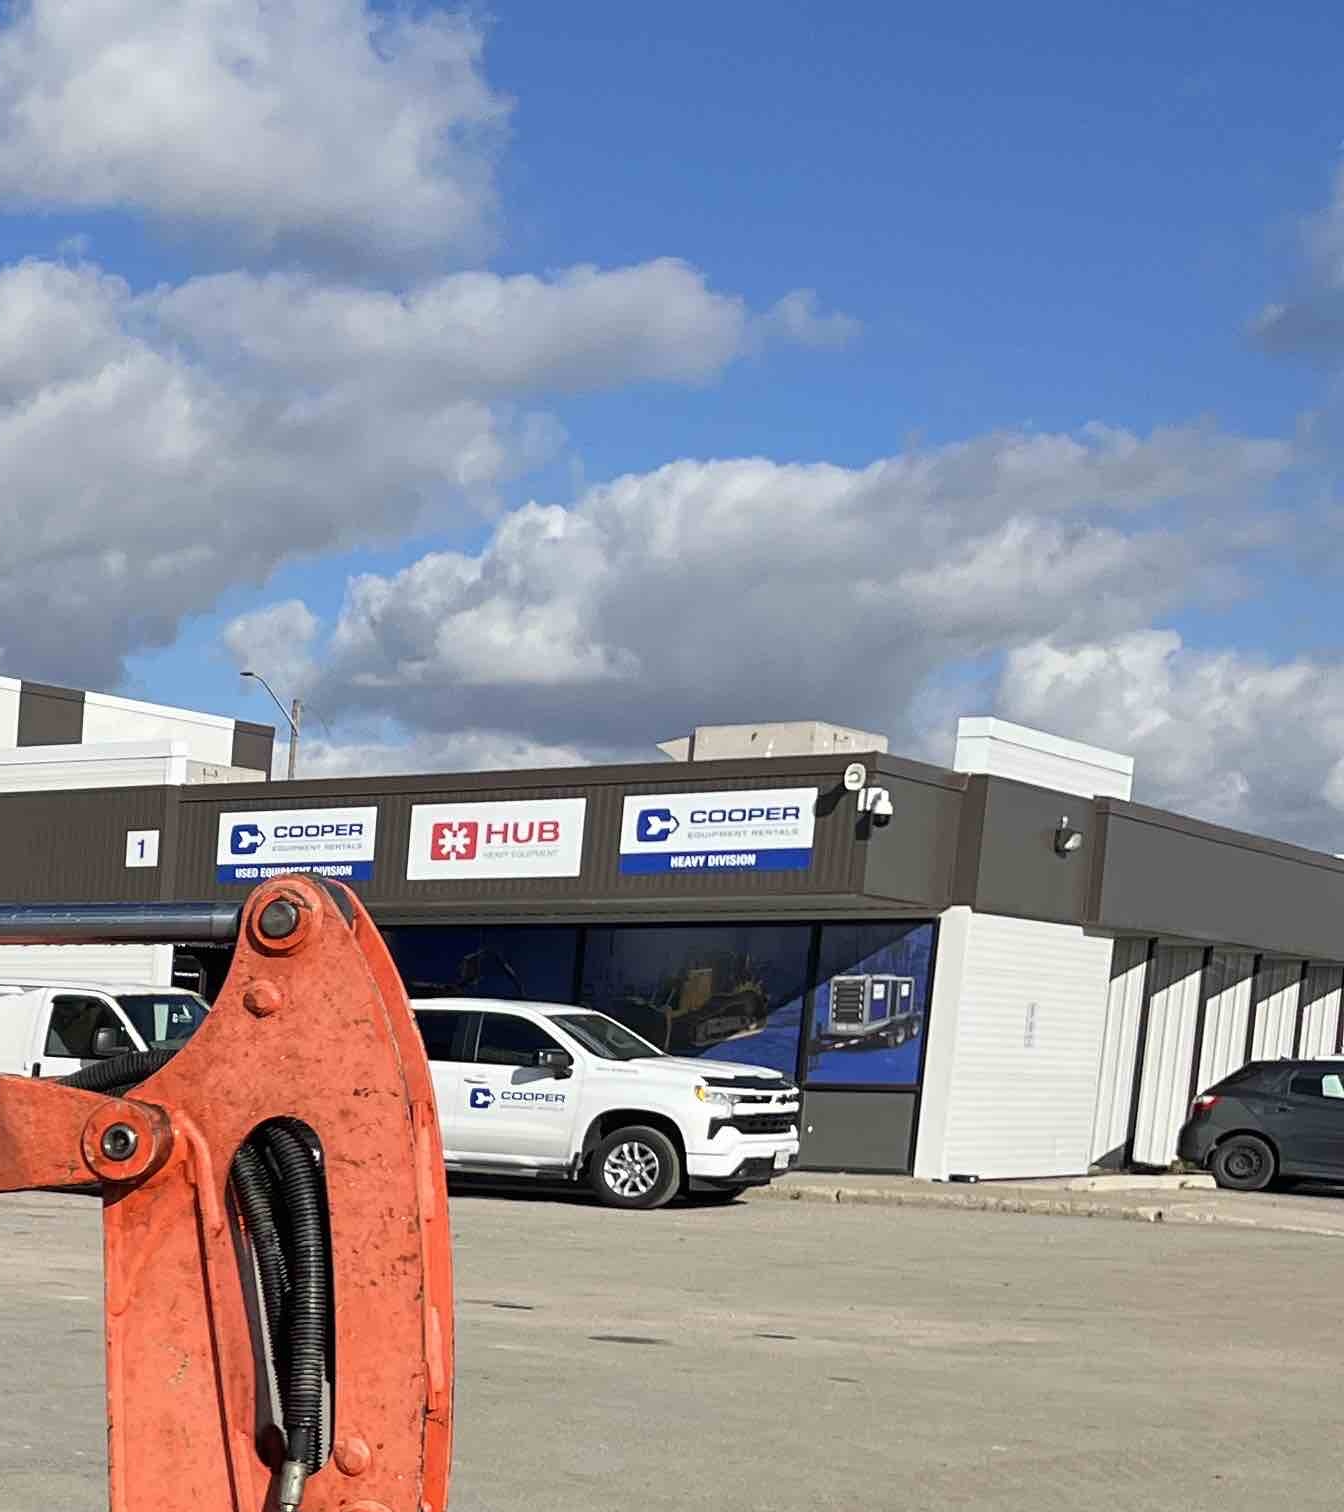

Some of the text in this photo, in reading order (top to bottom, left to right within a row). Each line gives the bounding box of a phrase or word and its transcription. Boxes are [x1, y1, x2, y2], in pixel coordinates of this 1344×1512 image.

[690, 807, 800, 824] COOPER
[274, 823, 363, 839] COOPER
[485, 820, 560, 844] HUB
[136, 839, 145, 859] 1
[670, 854, 756, 868] HEAVY DIVISION
[235, 868, 258, 879] USED
[500, 1091, 566, 1103] COOPER
